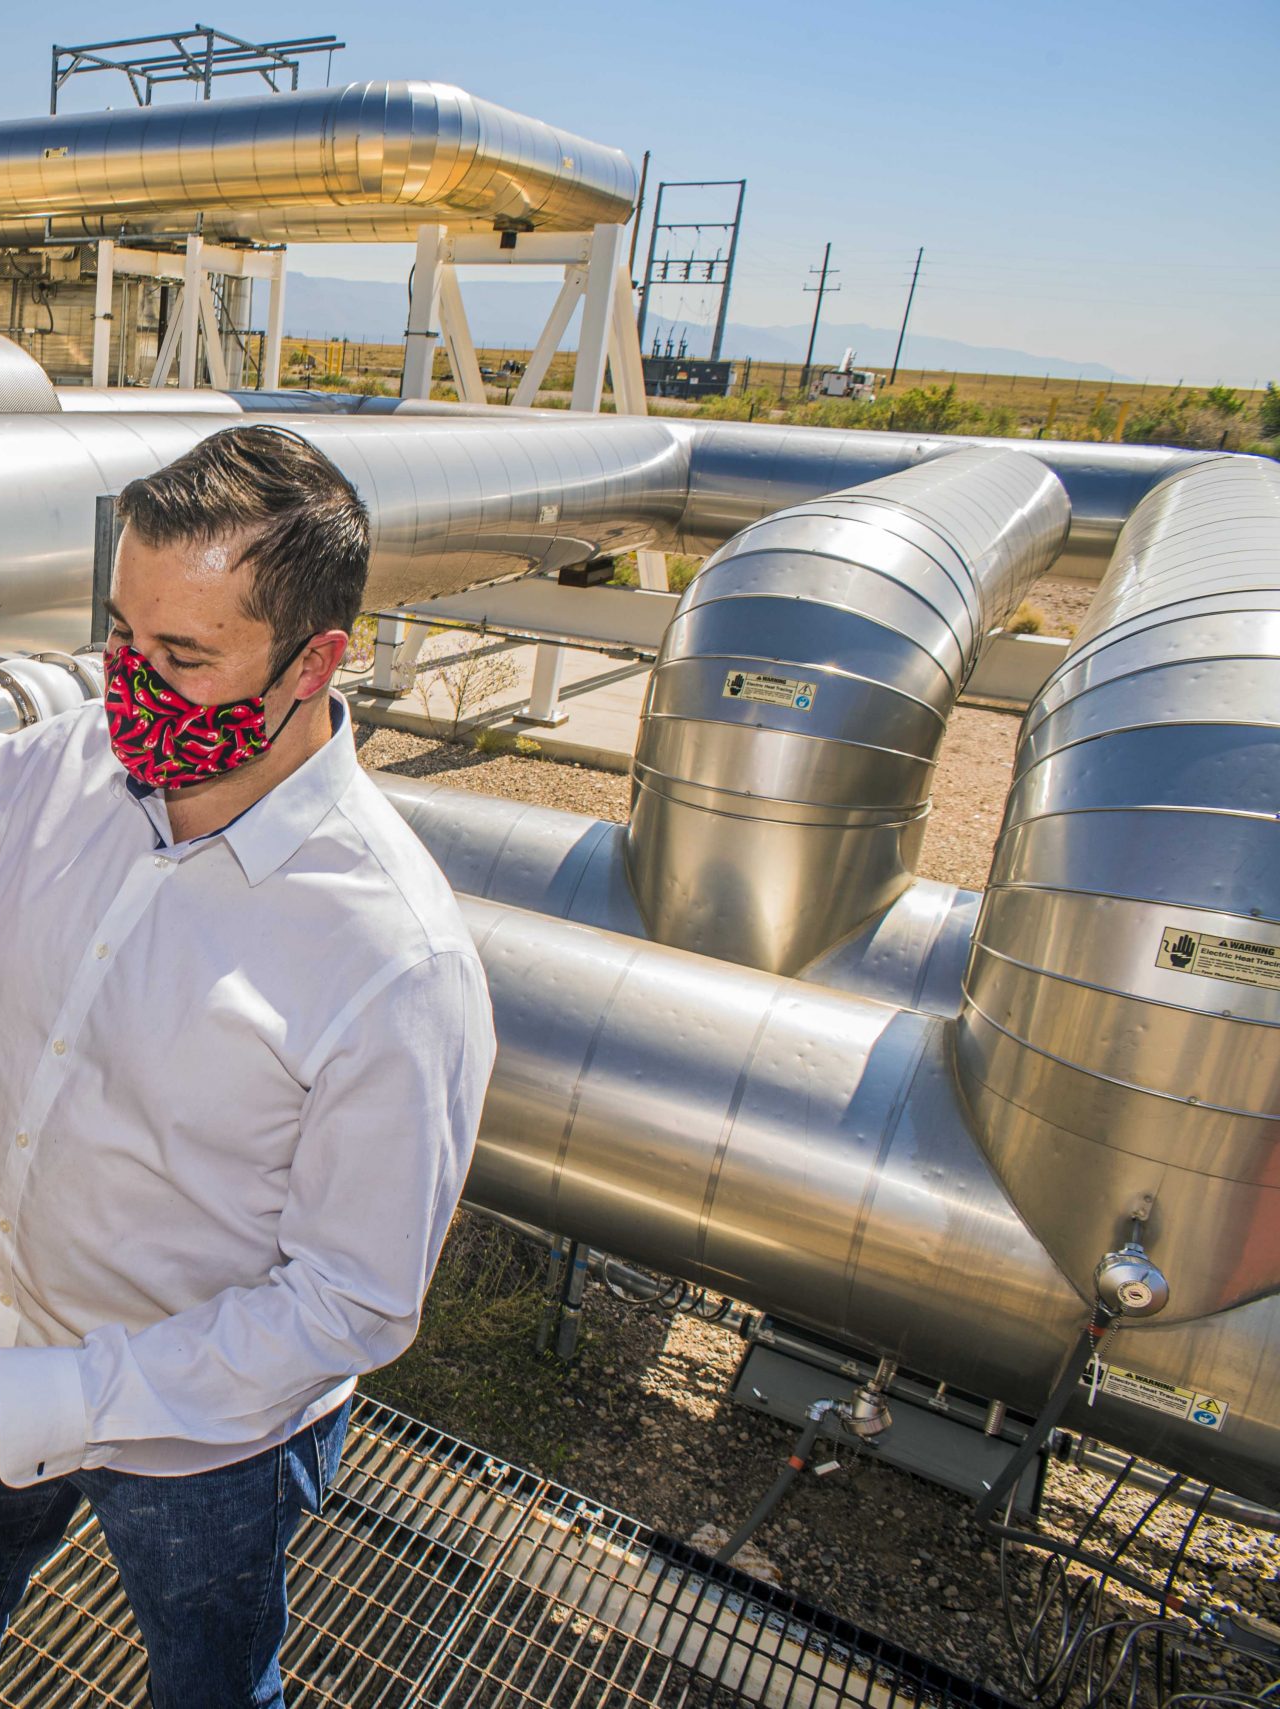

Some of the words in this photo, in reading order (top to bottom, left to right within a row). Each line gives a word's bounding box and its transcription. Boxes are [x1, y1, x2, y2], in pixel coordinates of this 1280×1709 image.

[763, 676, 786, 684] WARNING
[1230, 941, 1275, 956] WARNING
[1200, 948, 1232, 959] Electric
[1234, 954, 1255, 963] Heat
[1256, 958, 1280, 968] Tracin
[1109, 1374, 1138, 1388] Electric
[1139, 1384, 1158, 1394] Heat
[1160, 1391, 1188, 1405] Tracing
[1134, 1374, 1176, 1392] WARNING
